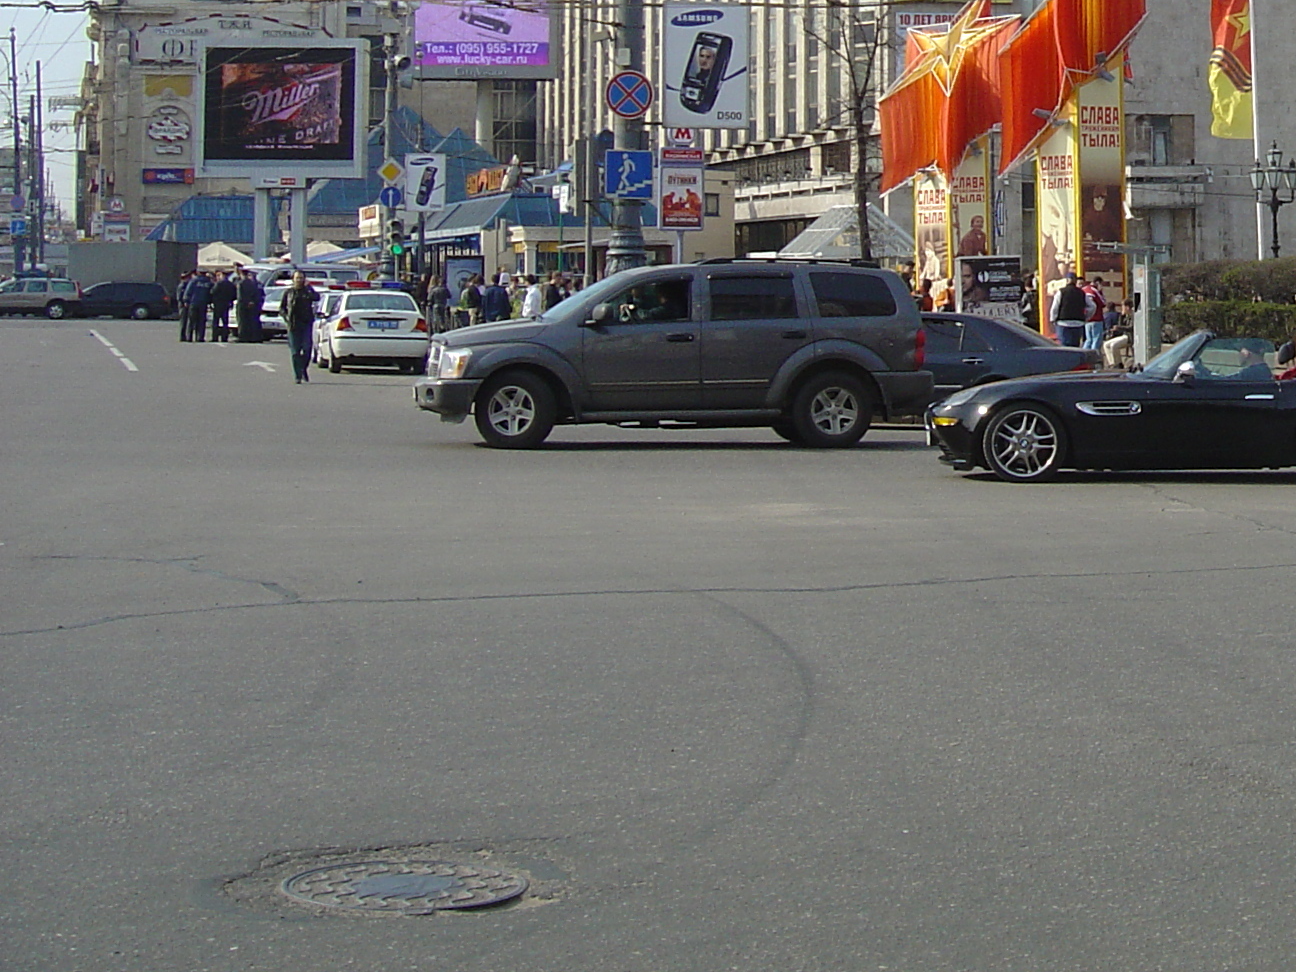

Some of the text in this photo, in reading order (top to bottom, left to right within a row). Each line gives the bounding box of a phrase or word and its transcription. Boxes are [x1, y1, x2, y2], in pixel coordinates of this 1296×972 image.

[676, 14, 719, 23] SAMSUNG
[900, 14, 911, 26] 10
[914, 14, 932, 26] ЛЕТ
[455, 42, 484, 56] (095)
[486, 43, 539, 54] 955-1727
[436, 55, 528, 66] www.lucky-car.ru
[242, 83, 320, 125] Miller
[716, 111, 743, 120] D500
[1081, 106, 1119, 125] СЛАВА
[1081, 133, 1120, 147] ТЫЛА!
[1041, 155, 1073, 171] СЛАВА
[1041, 178, 1073, 189] ТЫЛА!
[918, 189, 946, 205] СЛАВА
[953, 194, 985, 204] ТЫЛА!
[918, 212, 947, 224] ТЫЛА!
